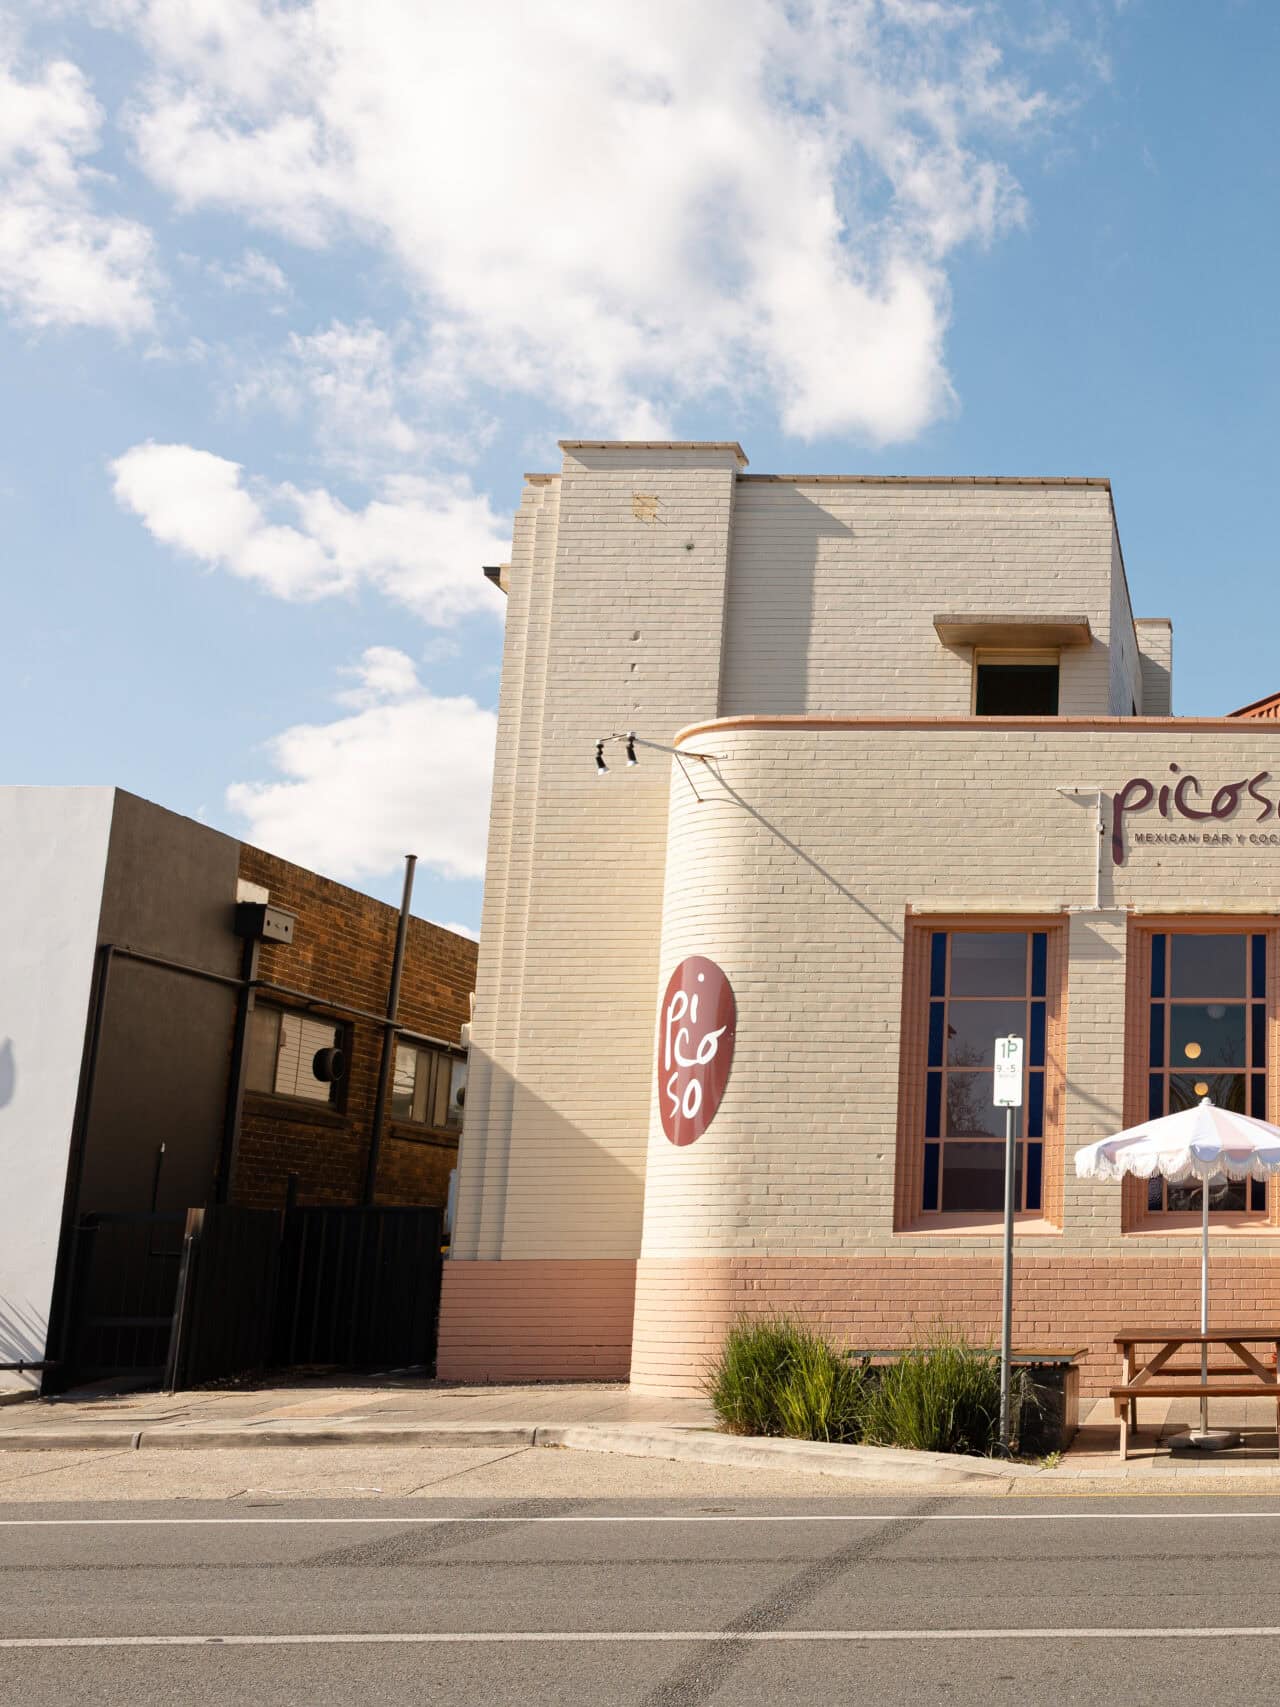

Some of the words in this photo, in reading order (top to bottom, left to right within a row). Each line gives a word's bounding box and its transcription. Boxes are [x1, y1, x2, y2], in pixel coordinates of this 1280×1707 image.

[1134, 833, 1197, 843] MEXICAN
[1203, 833, 1230, 843] BAR
[1236, 833, 1243, 843] Y
[1001, 1043, 1018, 1058] 1P
